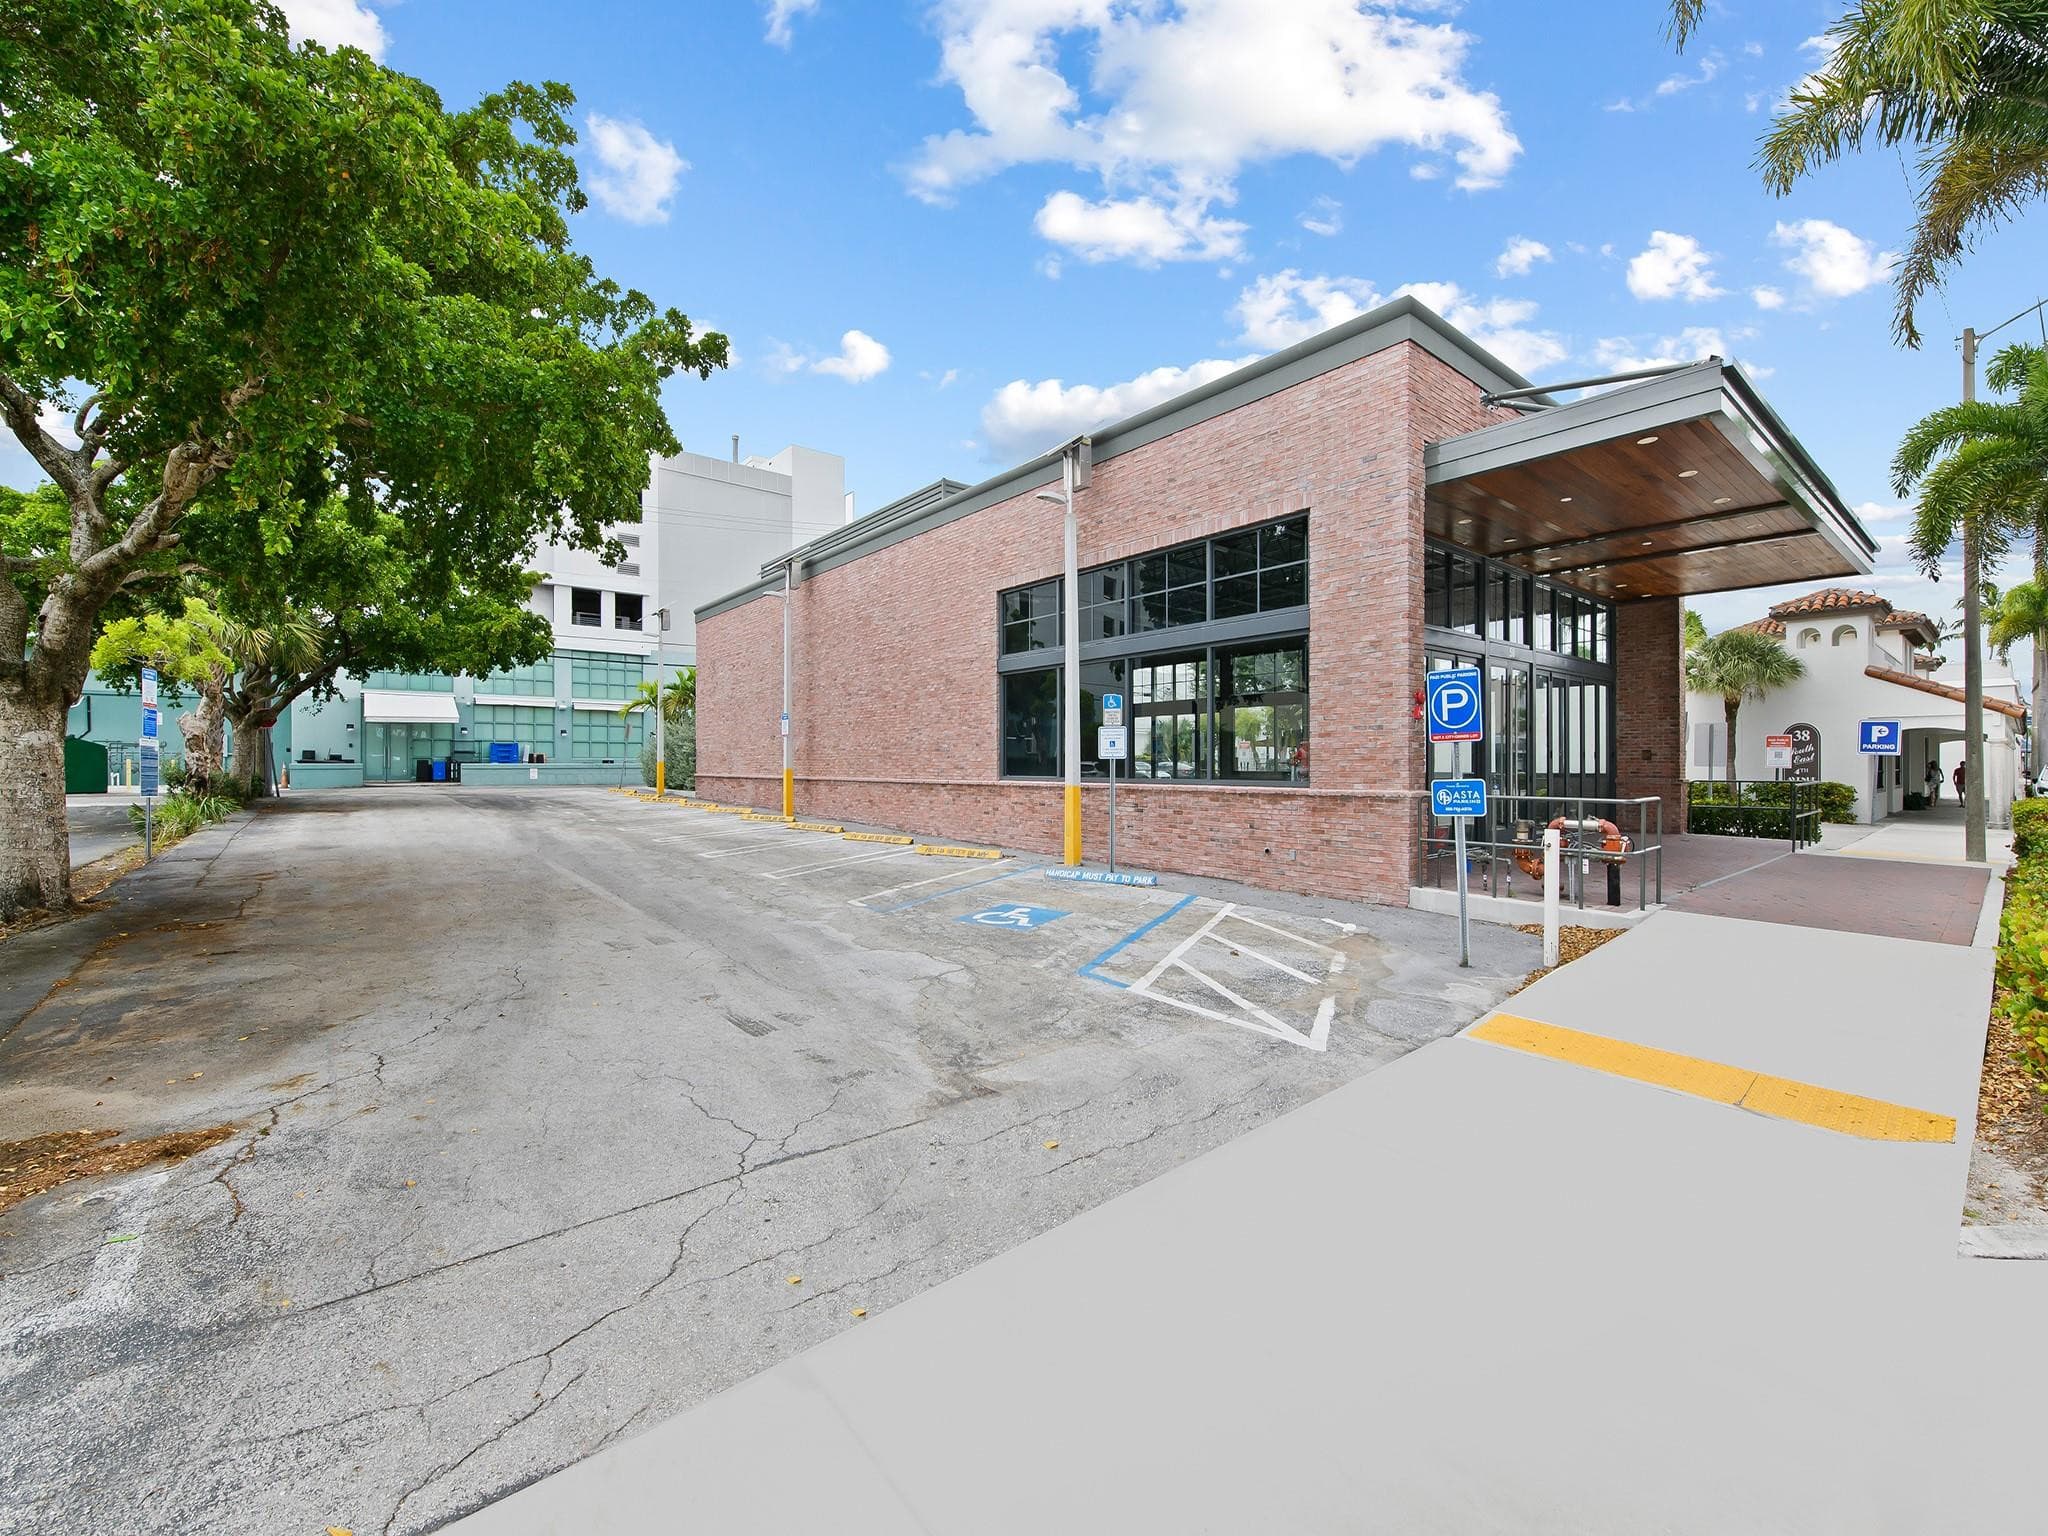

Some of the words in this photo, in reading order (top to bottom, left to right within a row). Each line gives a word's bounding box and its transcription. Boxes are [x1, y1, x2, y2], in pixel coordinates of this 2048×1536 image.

[1441, 688, 1469, 721] P
[1792, 730, 1810, 741] 38
[1452, 790, 1481, 799] ASTA
[1045, 868, 1081, 880] HANDICAP
[1082, 870, 1104, 881] MUST
[1105, 873, 1121, 881] PAY
[1121, 875, 1131, 883] TO
[1133, 876, 1154, 885] PARK
